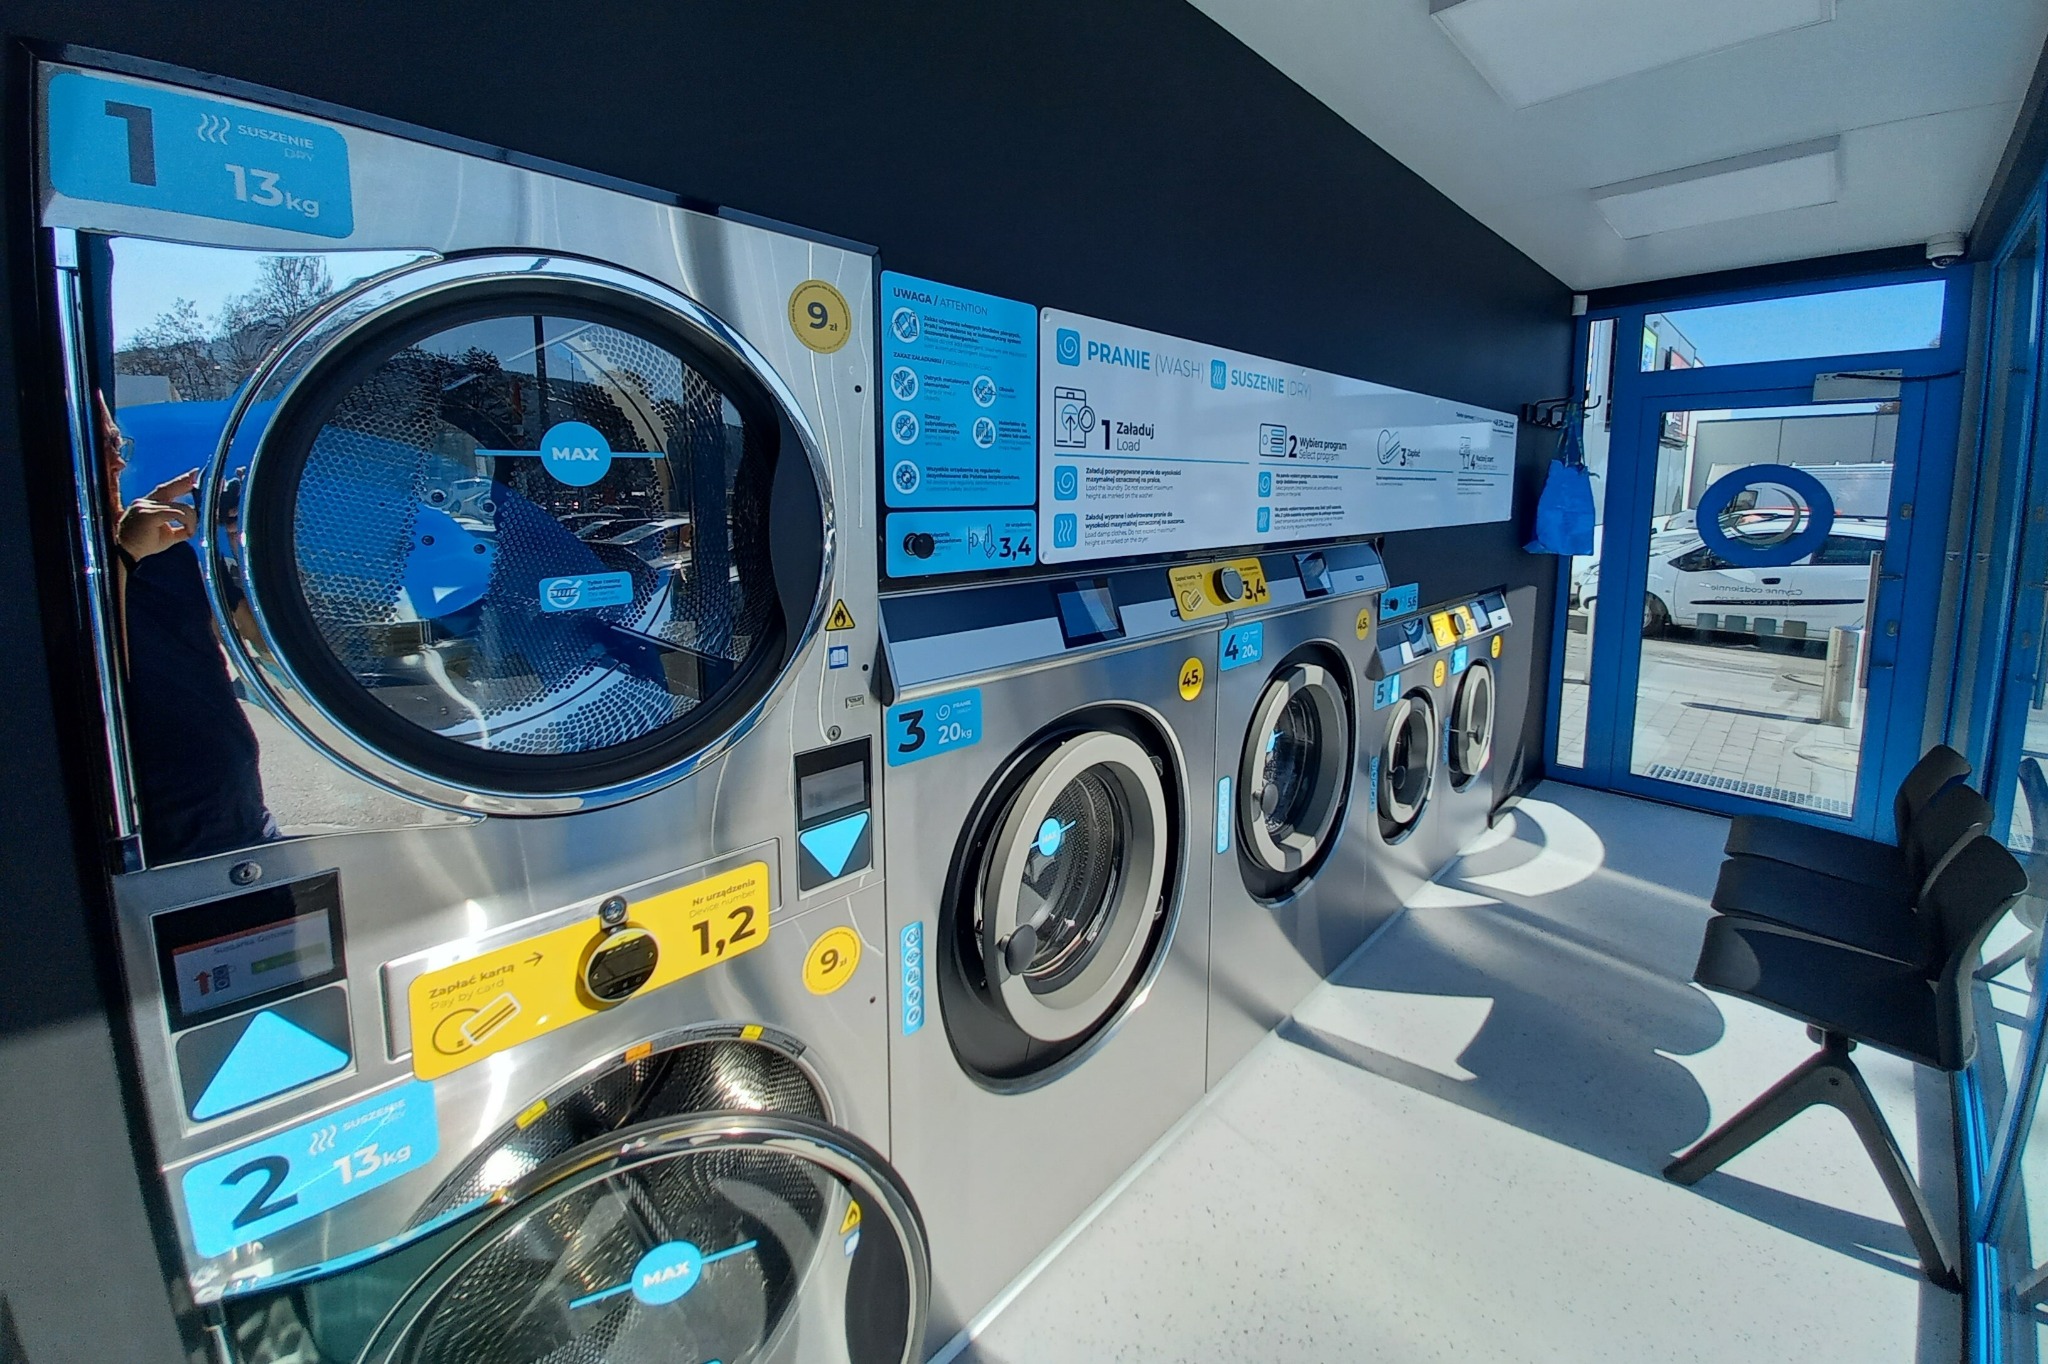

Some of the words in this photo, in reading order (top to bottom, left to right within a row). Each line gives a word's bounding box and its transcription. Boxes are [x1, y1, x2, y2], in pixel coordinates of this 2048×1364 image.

[105, 101, 156, 186] 1
[238, 125, 314, 149] SUSZENIE
[893, 287, 932, 305] UWAGA
[940, 299, 988, 315] ATTENTION
[1087, 340, 1150, 371] PRANIE
[1154, 353, 1204, 384] (WASH)
[1231, 369, 1285, 394] SUSZENIE
[1101, 419, 1111, 450] 1
[1116, 421, 1155, 440] Załaduj
[1116, 437, 1140, 452] Load
[1289, 435, 1297, 458] 2
[1299, 437, 1323, 449] Wybierz
[1324, 441, 1347, 451] program
[552, 447, 599, 461] MAX
[1299, 449, 1316, 459] Select
[1400, 448, 1406, 466] 3
[1470, 454, 1475, 470] 4
[999, 536, 1032, 560] 3,4
[1243, 578, 1266, 602] 3,4
[1225, 634, 1239, 660] 4
[1377, 683, 1384, 703] 5
[898, 709, 926, 753] 3
[689, 901, 719, 919] Device
[721, 889, 755, 906] number
[692, 896, 704, 907] Nr
[706, 879, 755, 901] urządzenia
[692, 905, 756, 957] 1,2
[429, 974, 477, 1000] Zapłać
[480, 964, 515, 982] kartą
[458, 991, 474, 1001] by
[477, 978, 505, 995] card
[220, 1155, 298, 1231] 2
[642, 1260, 690, 1288] MAX
